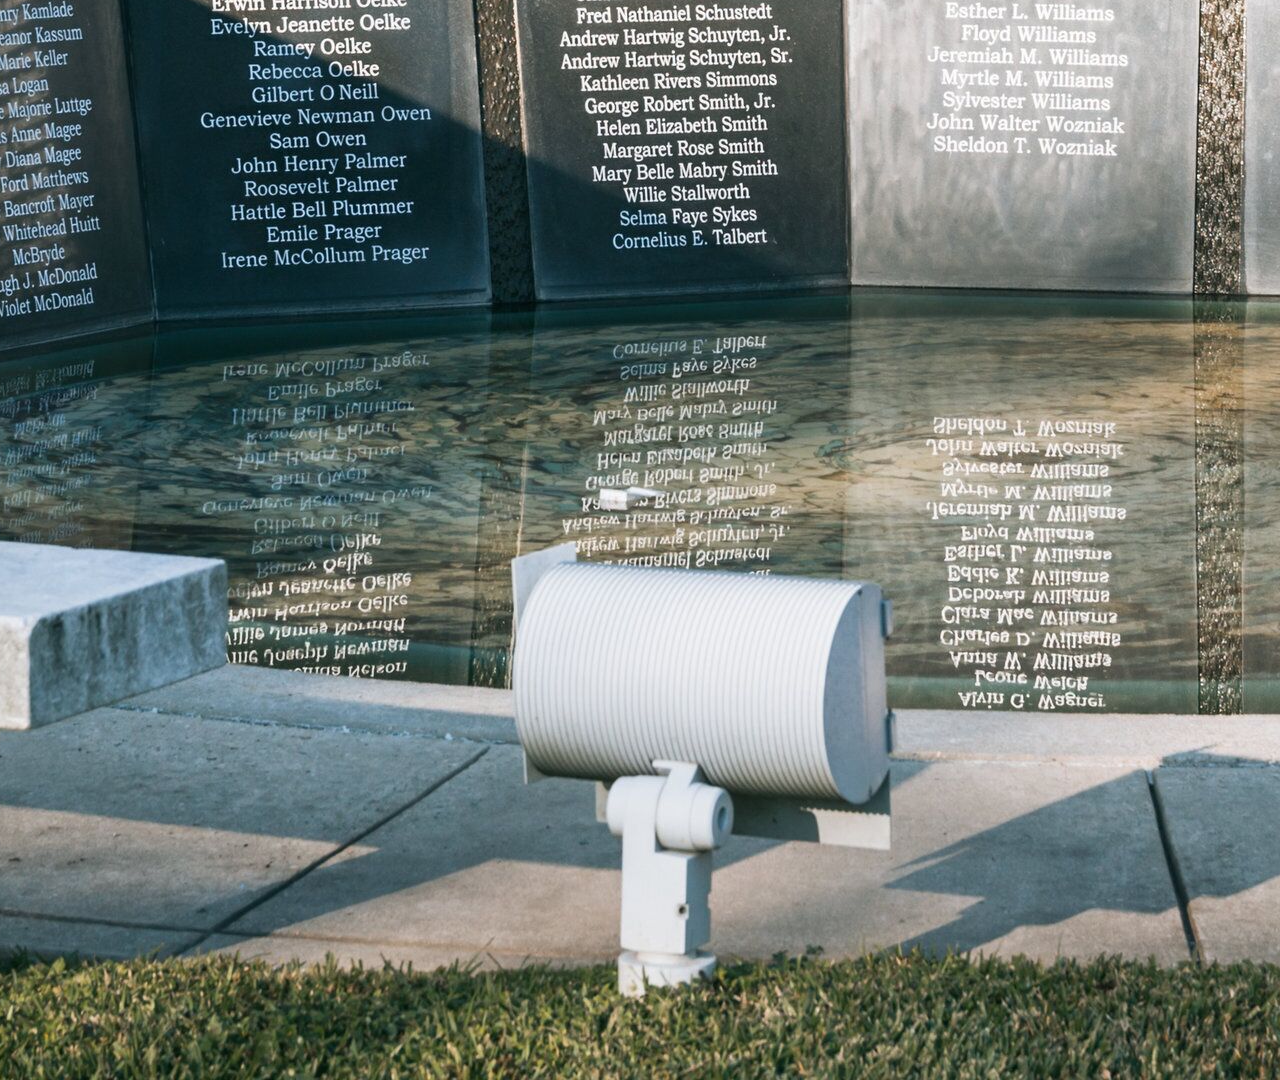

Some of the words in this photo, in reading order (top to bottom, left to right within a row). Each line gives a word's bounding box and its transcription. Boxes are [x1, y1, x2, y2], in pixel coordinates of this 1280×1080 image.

[576, 6, 612, 24] Fred
[616, 4, 691, 23] Nathaniel
[695, 3, 773, 21] Schustedt
[211, 15, 272, 38] Evelyn
[276, 16, 355, 33] Jeanette
[359, 13, 411, 31] Oelke
[962, 24, 1011, 45] Floyd
[1017, 26, 1096, 43] Williams
[580, 74, 650, 92] Kathleen
[653, 72, 702, 89] Rivers
[706, 71, 777, 88] Simmons
[943, 91, 1026, 112] Sylvester
[1031, 93, 1111, 111] Williams
[201, 110, 291, 128] Genevieve
[297, 109, 375, 124] Newman
[381, 106, 431, 121] Owen
[926, 113, 975, 130] John
[980, 114, 1041, 132] Walter
[1045, 116, 1125, 136] Wozniak
[934, 135, 1008, 153] Sheldon
[1013, 137, 1031, 154] T.
[1038, 138, 1117, 156] Wozniak
[0, 173, 30, 194] Ford
[31, 170, 89, 188] Matthews
[623, 186, 666, 203] Willie
[671, 183, 750, 201] Stallworth
[12, 243, 65, 266] McBryde
[221, 252, 268, 268] Irene
[274, 247, 366, 266] McCollum
[371, 245, 429, 264] Prager
[33, 287, 94, 312] McDonald
